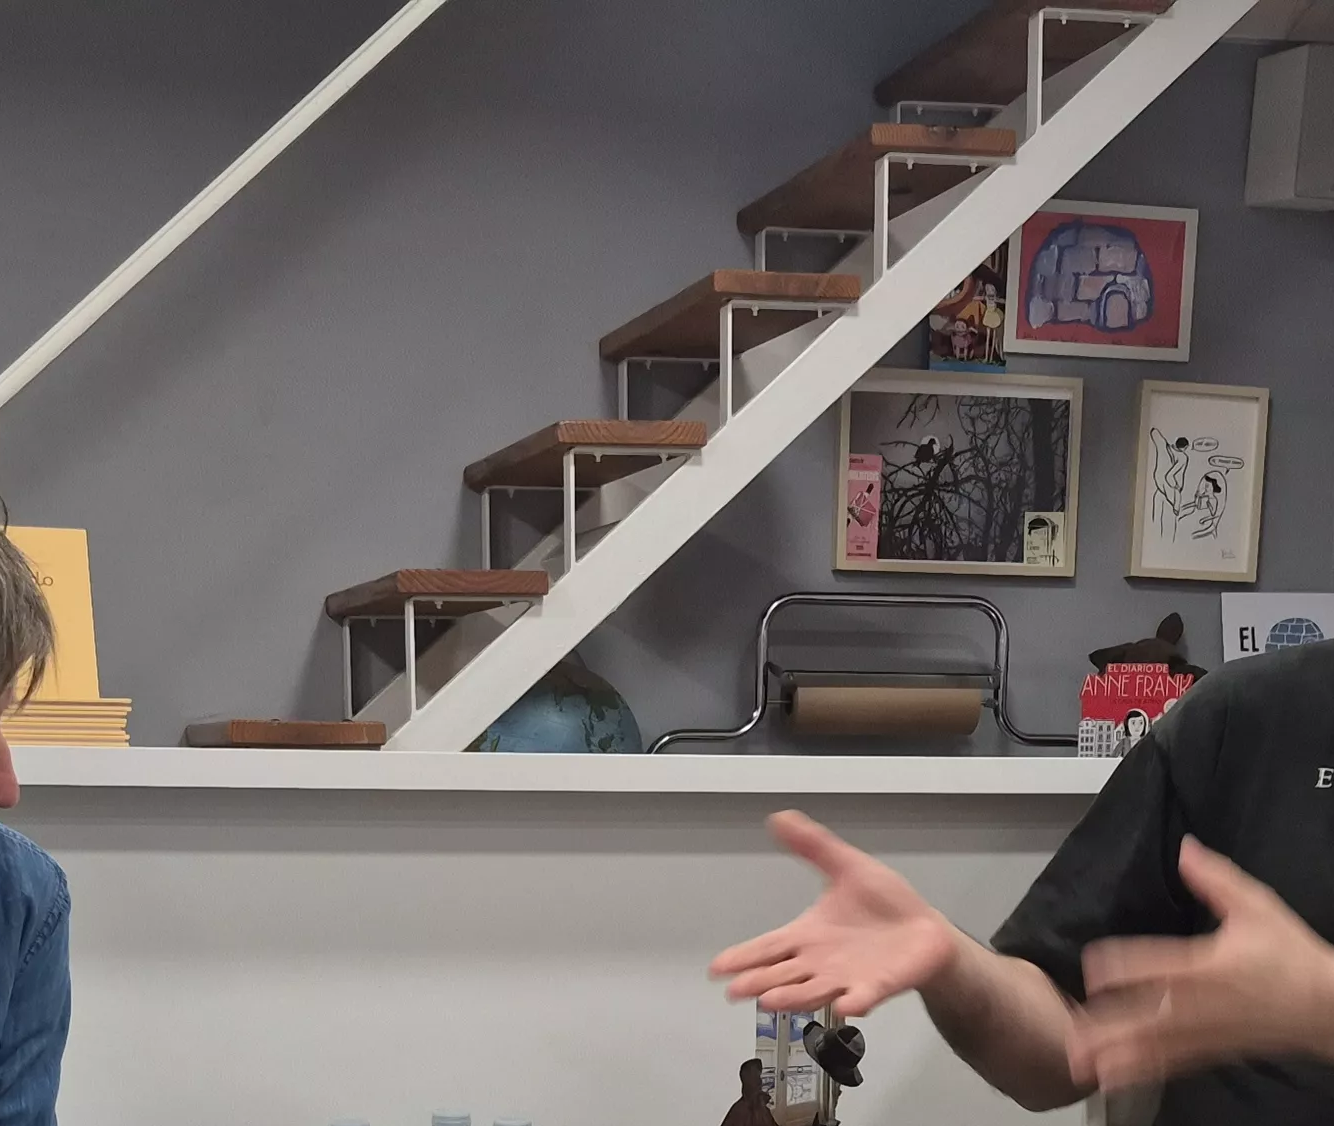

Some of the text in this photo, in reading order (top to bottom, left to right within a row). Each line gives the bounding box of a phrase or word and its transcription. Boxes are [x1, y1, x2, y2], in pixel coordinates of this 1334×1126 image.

[1240, 625, 1260, 652] EL
[1108, 664, 1168, 673] EL DIARIO DE
[1081, 674, 1193, 696] ANNE FRANK
